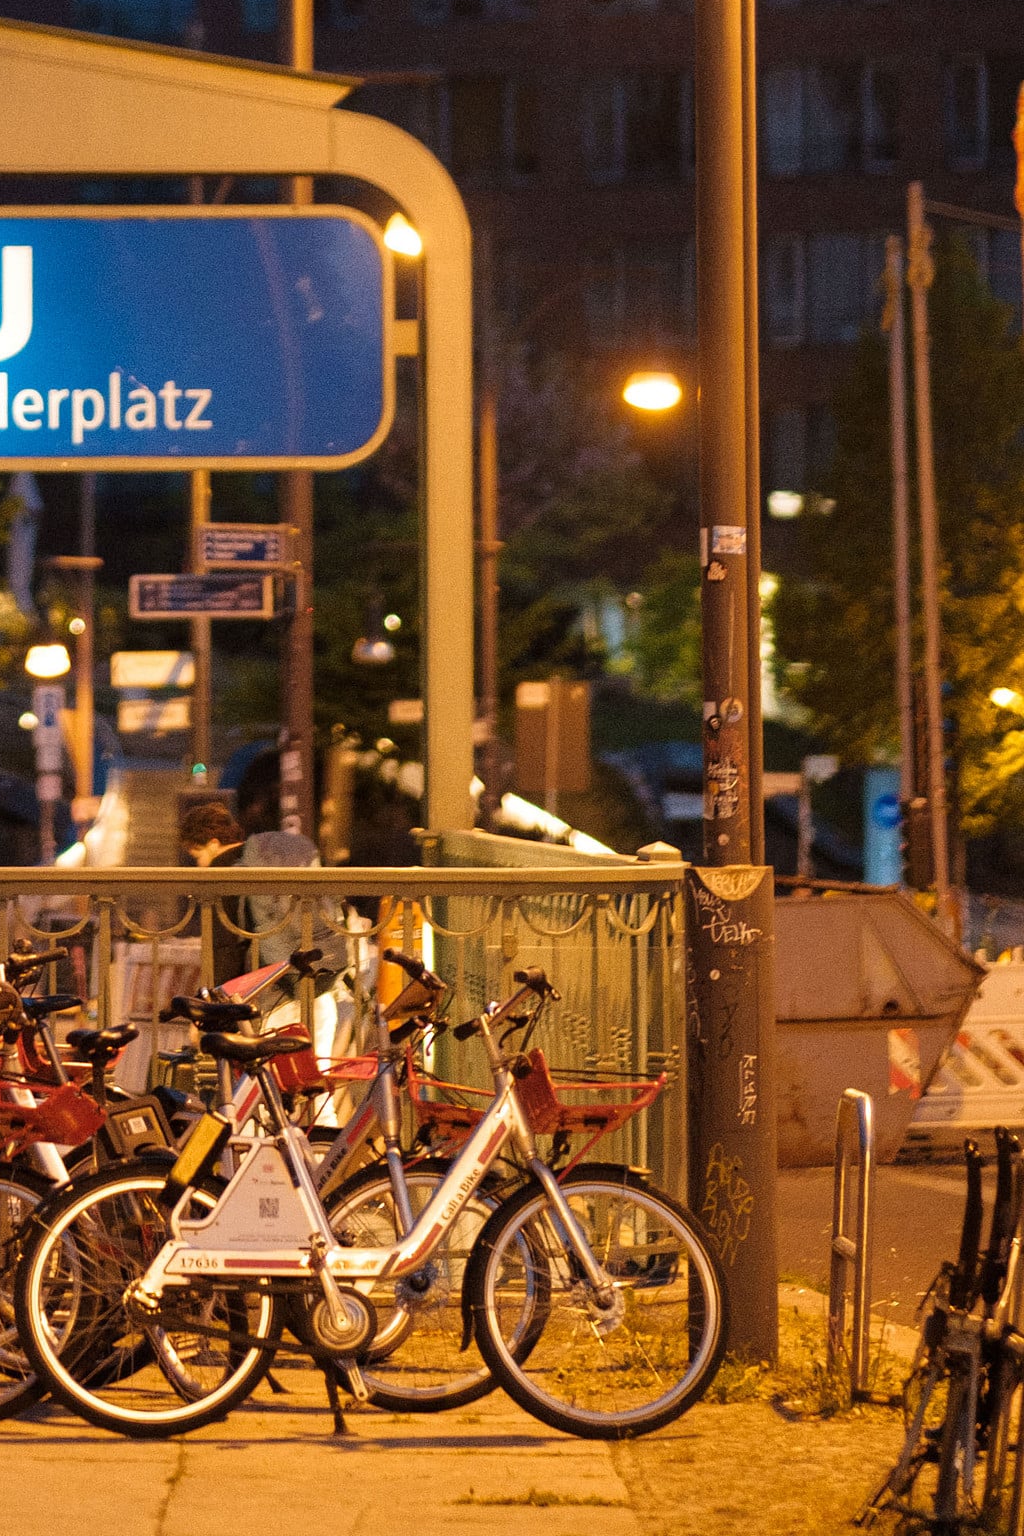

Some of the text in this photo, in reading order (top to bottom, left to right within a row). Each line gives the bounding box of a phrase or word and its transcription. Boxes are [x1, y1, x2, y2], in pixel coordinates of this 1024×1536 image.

[442, 1199, 459, 1220] Call
[462, 1168, 482, 1191] Bike
[180, 1257, 219, 1269] 17636
